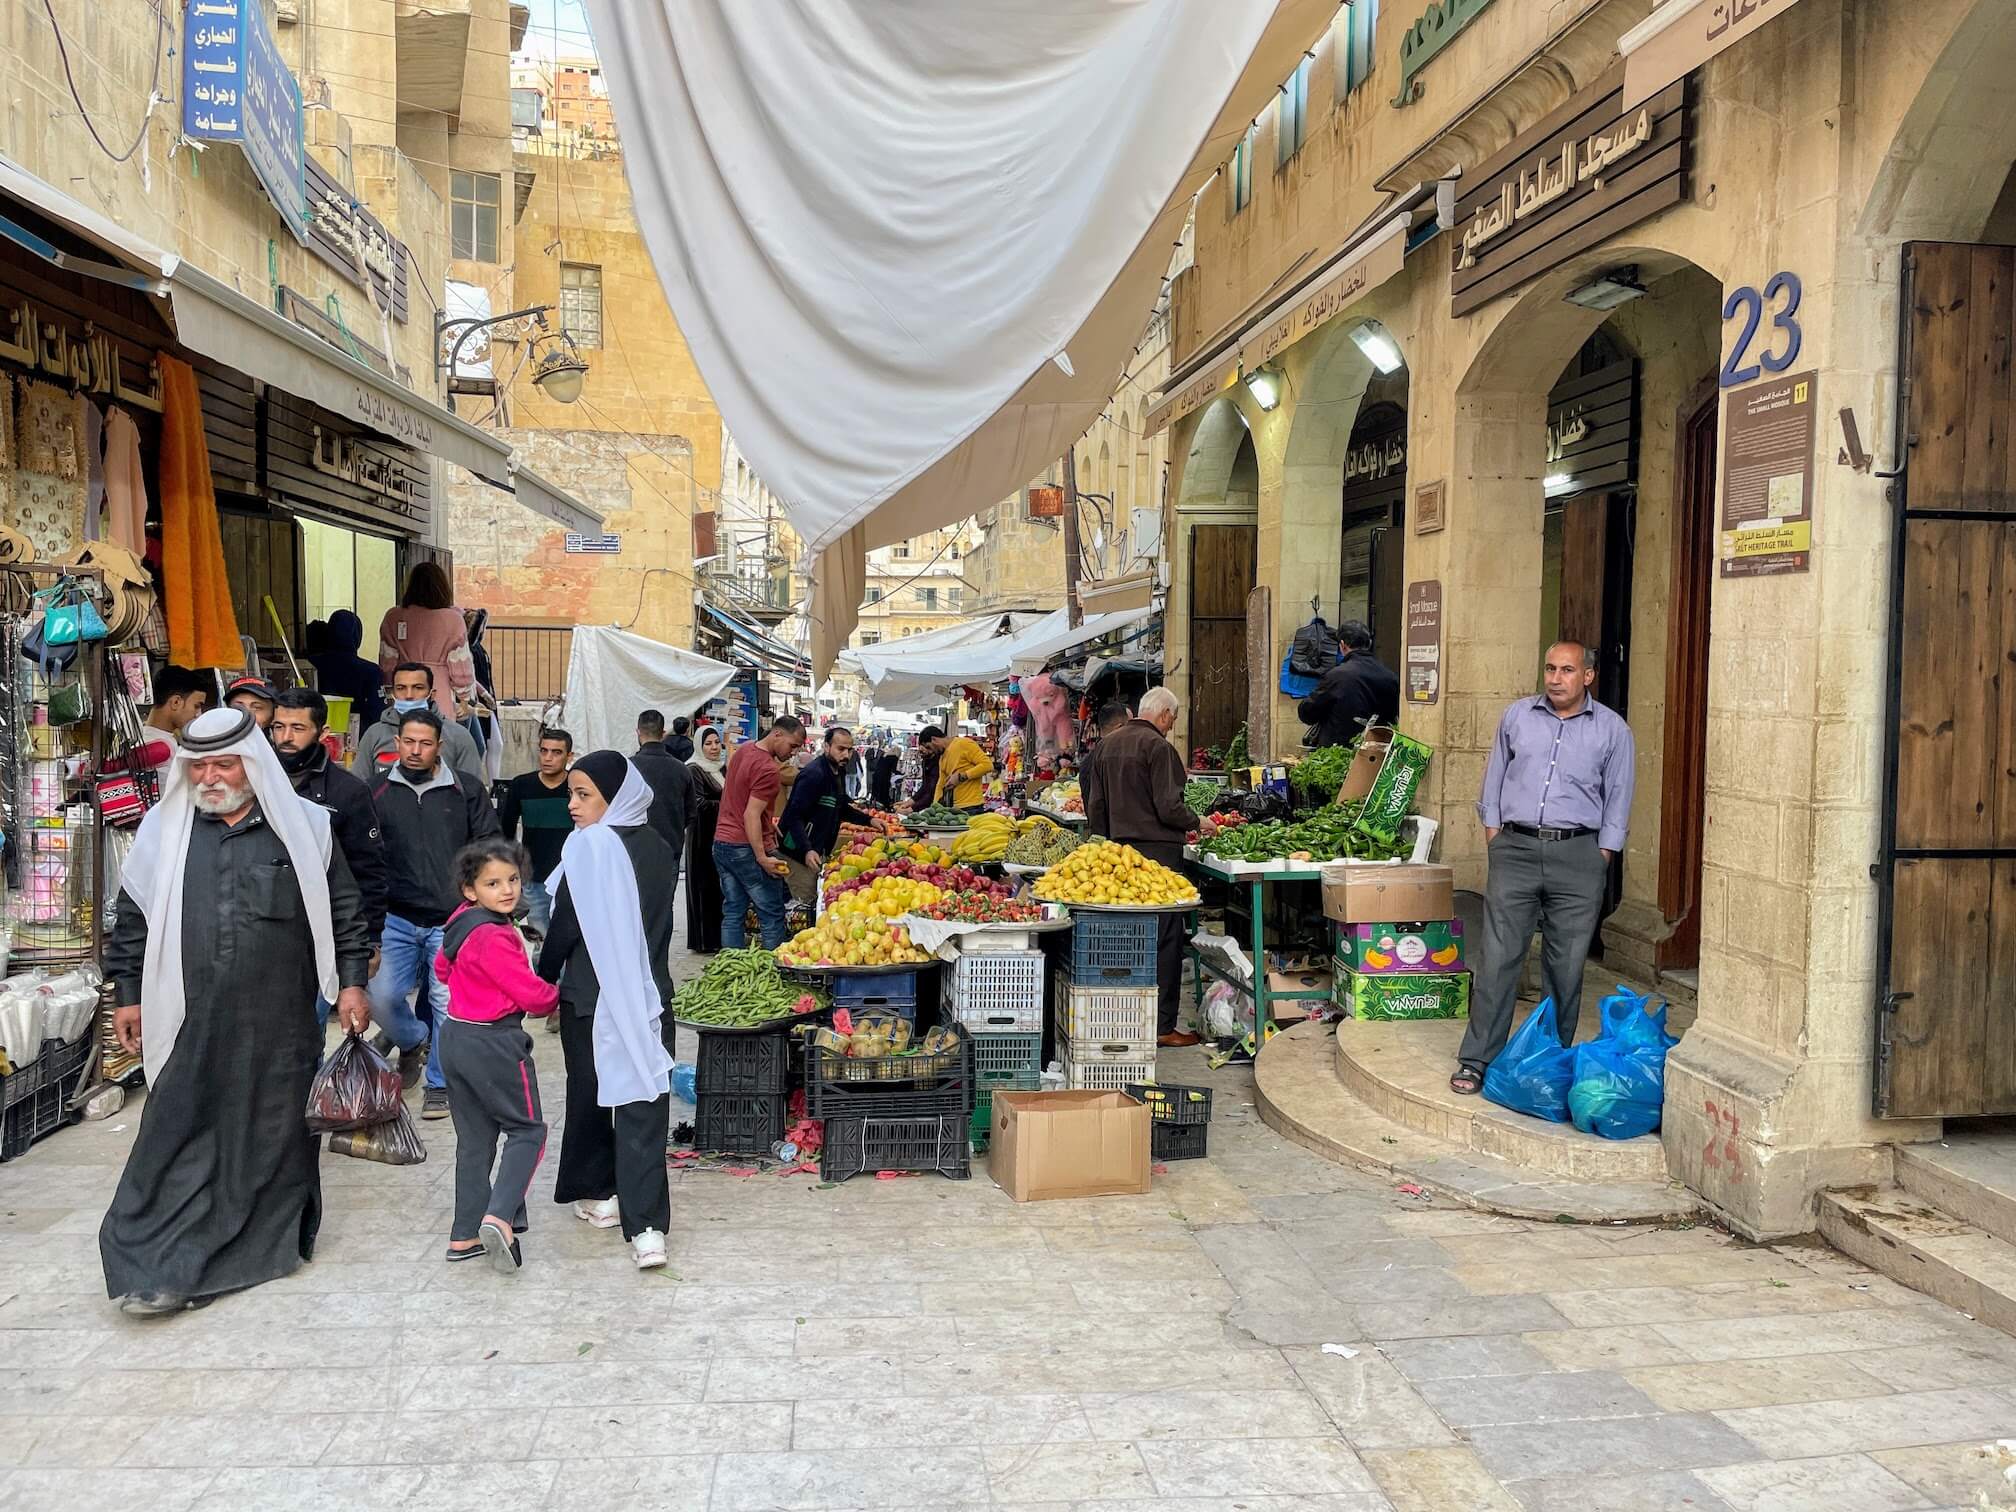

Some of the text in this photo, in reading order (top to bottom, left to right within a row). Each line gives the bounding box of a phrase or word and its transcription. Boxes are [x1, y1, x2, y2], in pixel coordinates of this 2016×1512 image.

[195, 26, 236, 49] الحياري
[193, 56, 237, 74] طب
[194, 82, 237, 106] وجراحة
[195, 112, 237, 131] عامة
[1456, 109, 1653, 270] مسجد السلط الصغير
[1720, 271, 1802, 388] 23
[1796, 386, 1805, 399] 11
[1748, 541, 1777, 551] HERITAGE
[1777, 539, 1794, 548] TRAIL
[1421, 600, 1438, 614] Mosque
[1386, 764, 1415, 815] IGUANA
[1385, 994, 1440, 1011] IGUANA
